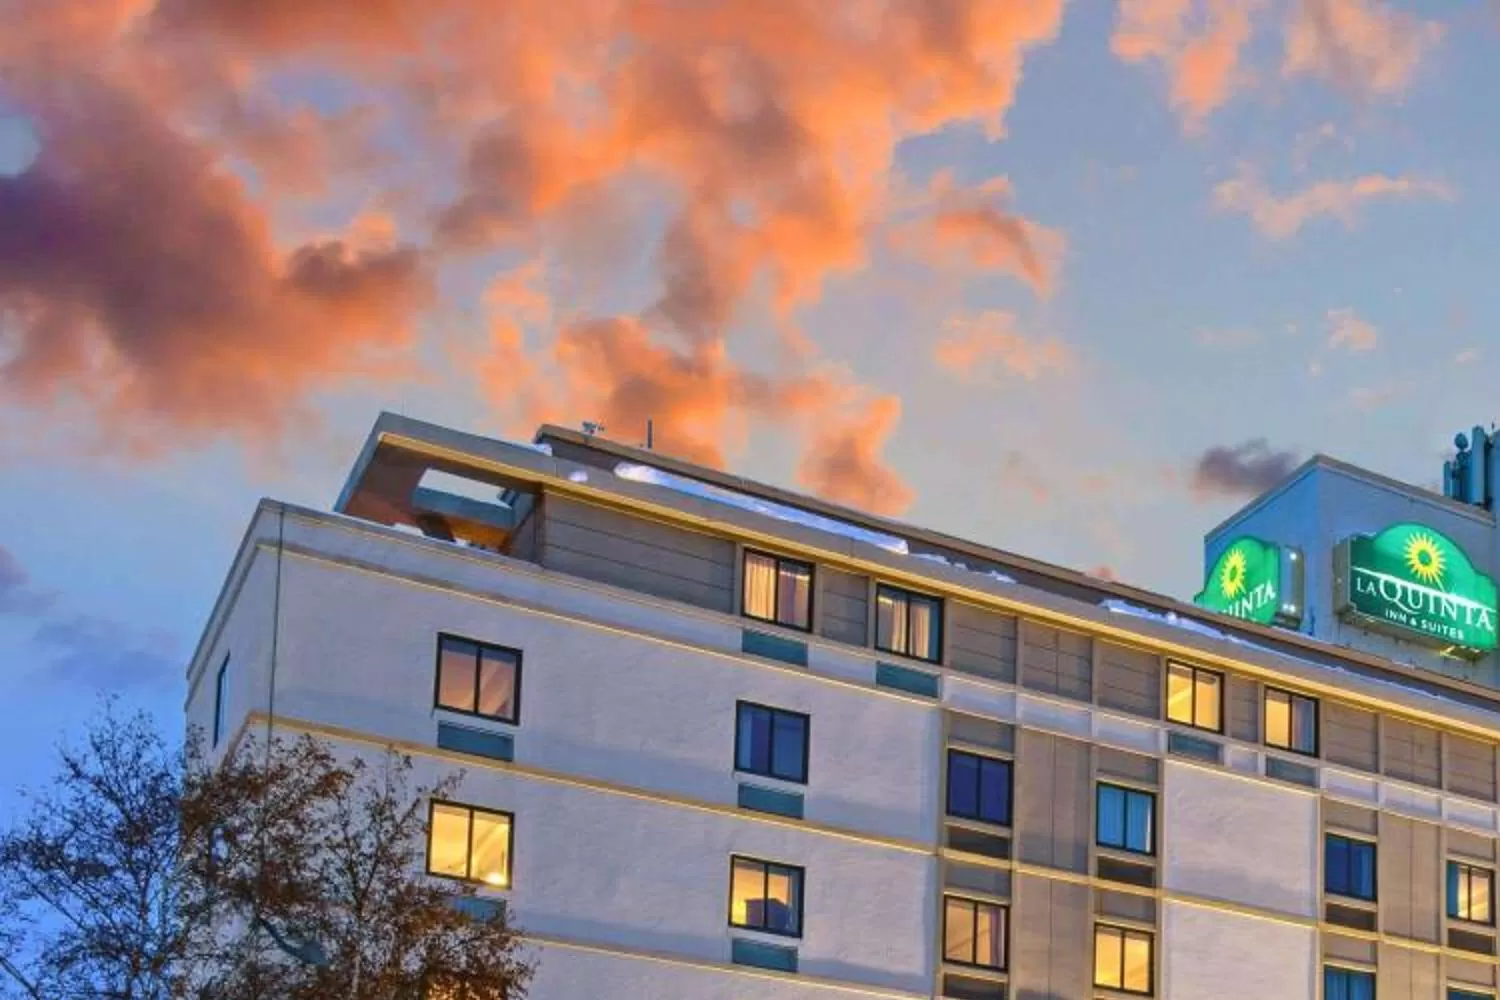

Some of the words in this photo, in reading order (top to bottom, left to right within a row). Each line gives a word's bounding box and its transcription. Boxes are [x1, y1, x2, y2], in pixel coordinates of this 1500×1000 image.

[1356, 577, 1377, 597] LA
[1380, 578, 1494, 631] QUINTA
[1385, 608, 1407, 624] INN
[1421, 619, 1465, 641] SUITES
